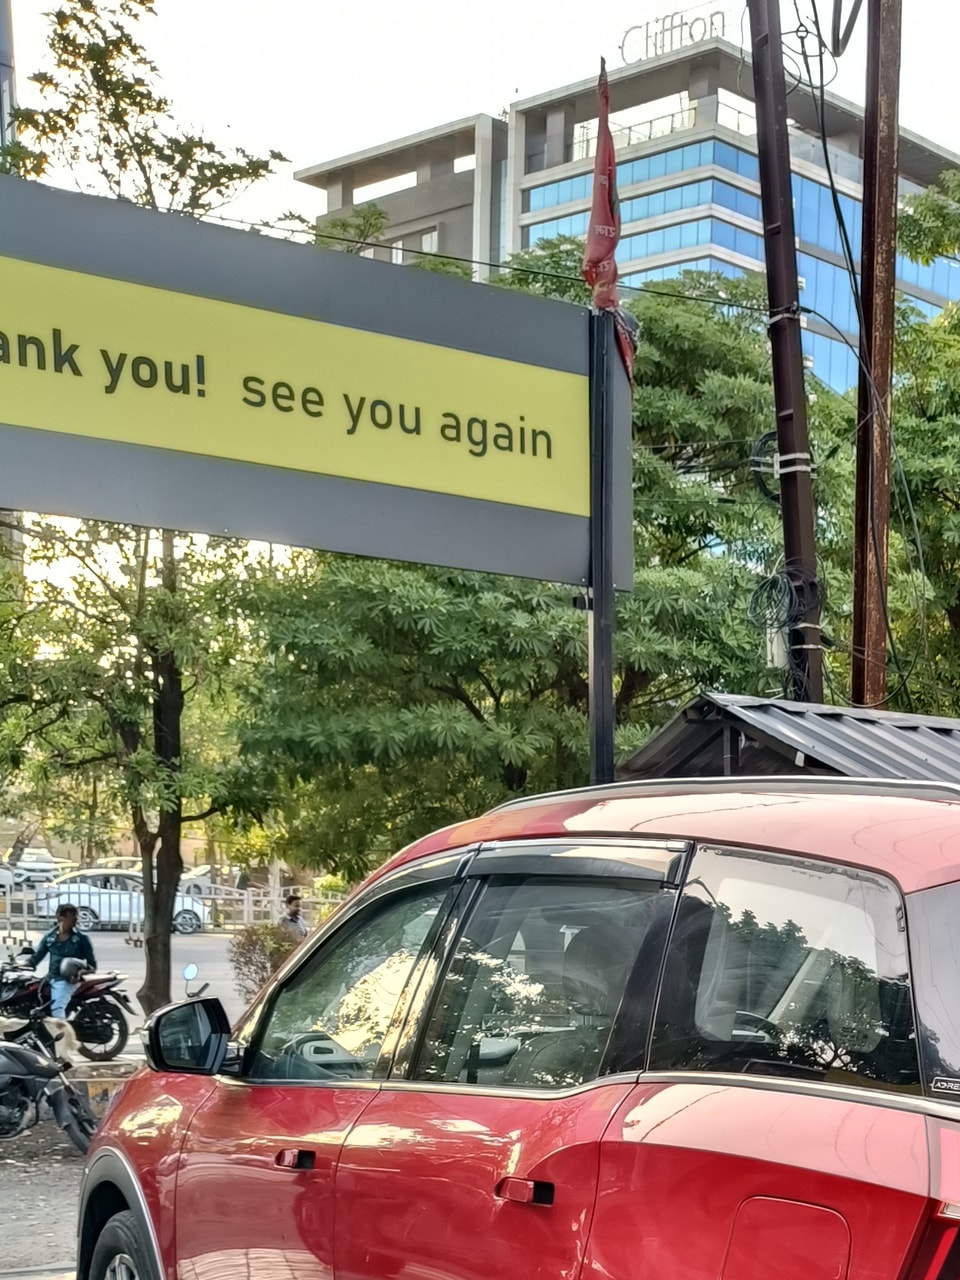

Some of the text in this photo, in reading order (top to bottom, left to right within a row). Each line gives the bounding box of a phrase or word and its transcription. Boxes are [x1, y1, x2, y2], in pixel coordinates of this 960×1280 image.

[620, 10, 726, 65] Cliffton
[100, 348, 206, 398] you!
[242, 376, 325, 418] see
[343, 393, 421, 435] you
[440, 411, 553, 459] again
